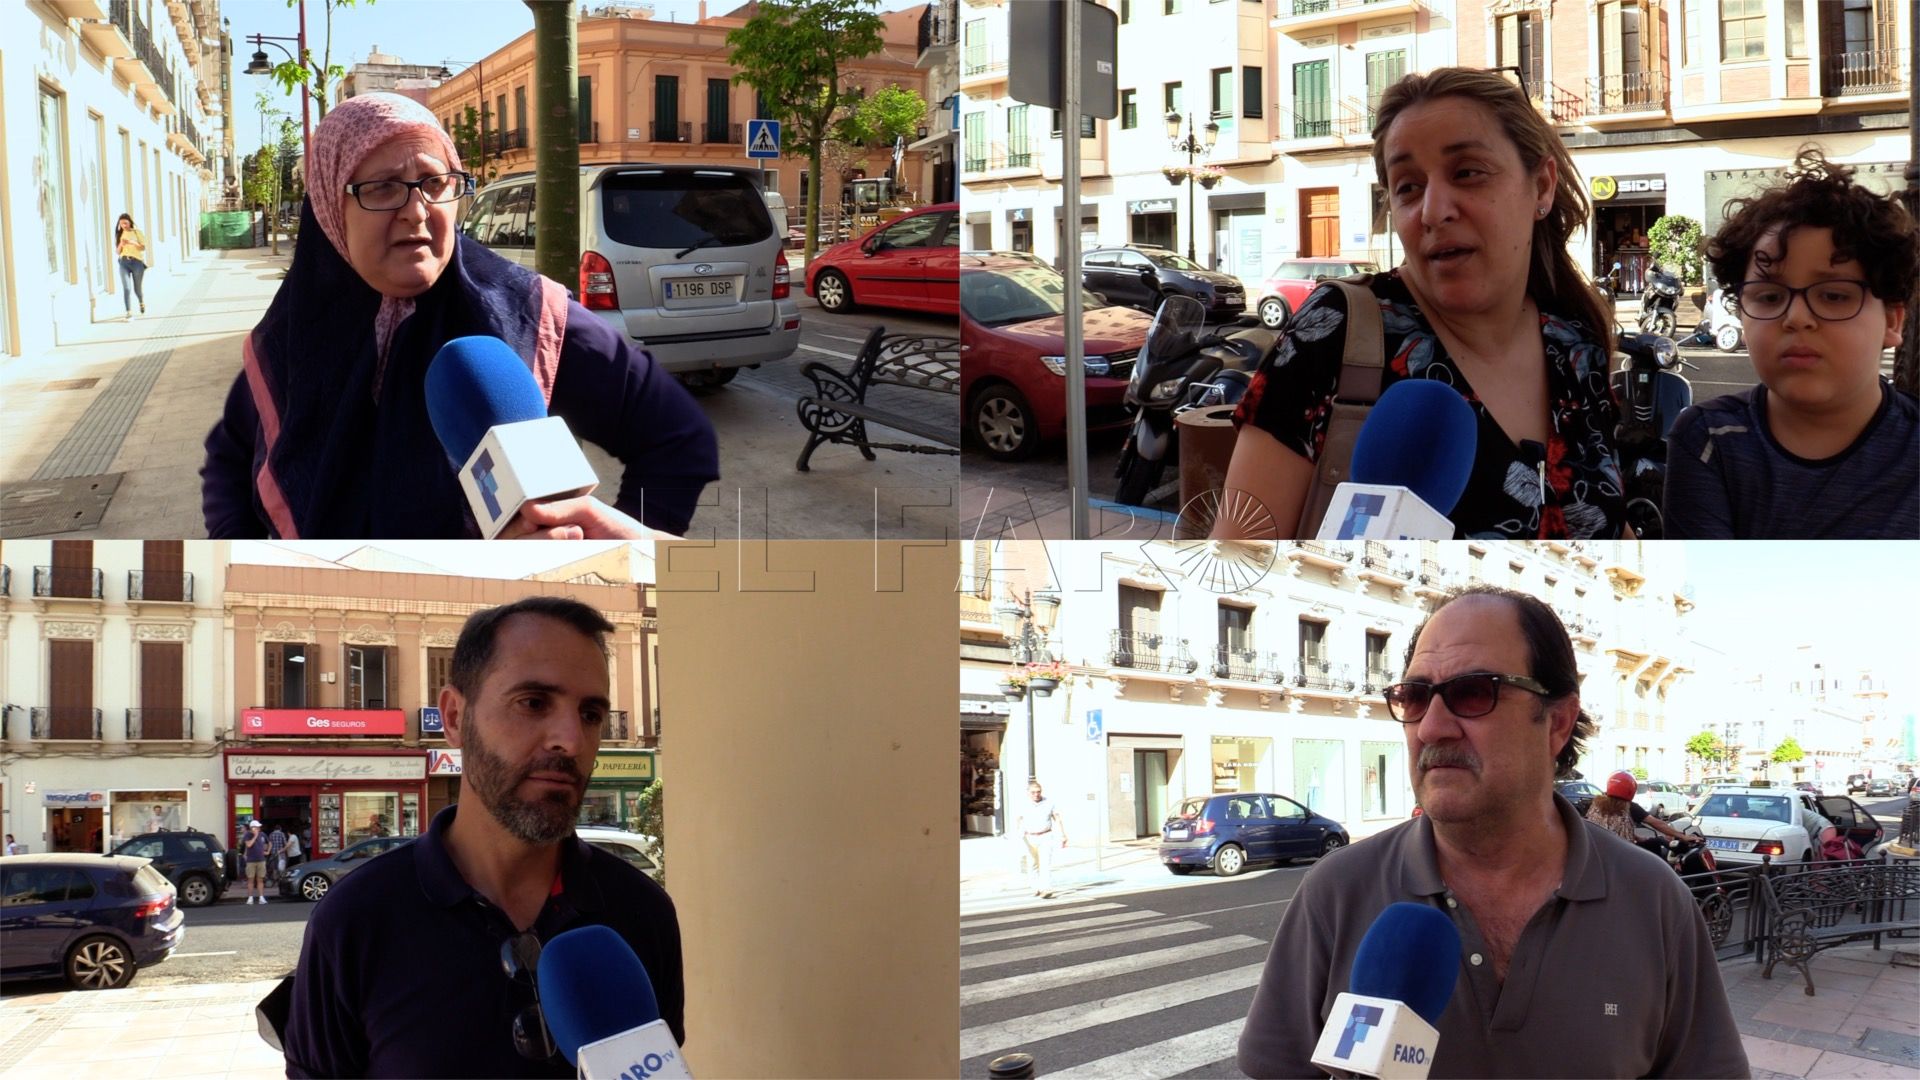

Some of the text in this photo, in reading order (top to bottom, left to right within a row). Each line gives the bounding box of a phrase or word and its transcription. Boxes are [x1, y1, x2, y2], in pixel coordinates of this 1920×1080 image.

[675, 281, 731, 296] 1196 DSP
[306, 716, 330, 728] Ges
[331, 720, 366, 728] SEGUROS
[234, 765, 276, 778] Calzados
[602, 762, 646, 770] PAPELERÍA
[1393, 1043, 1425, 1064] FARO
